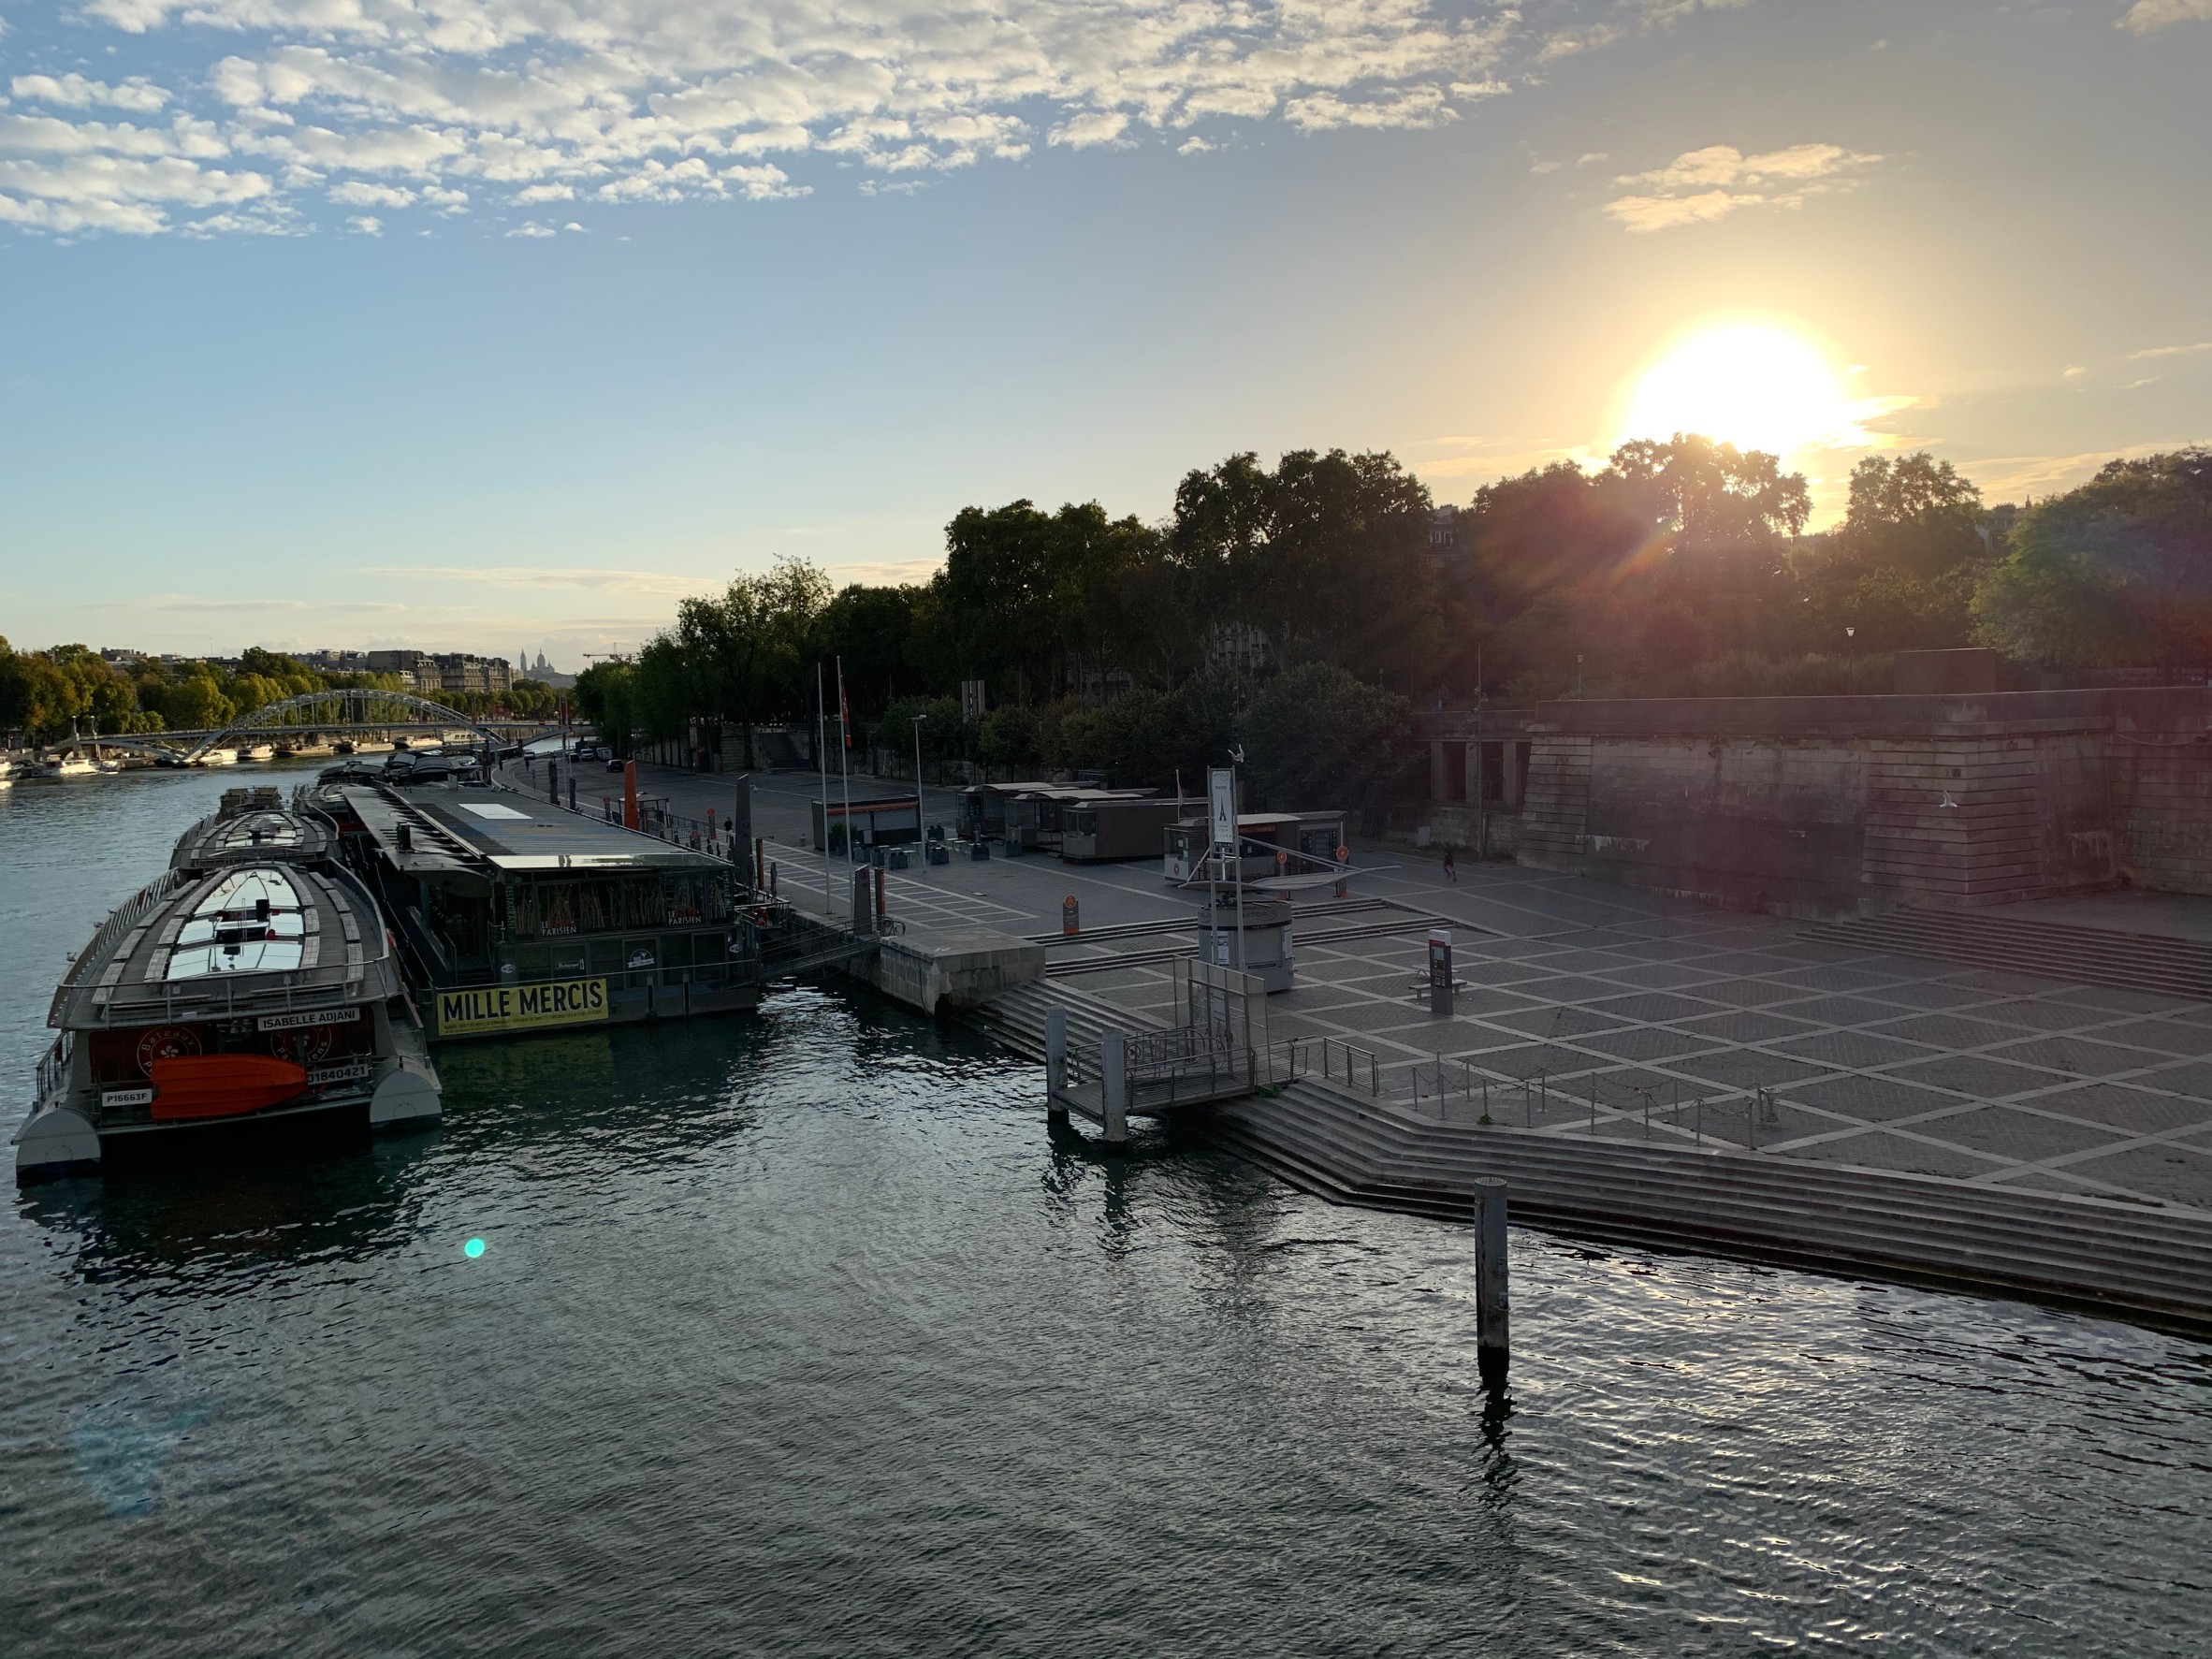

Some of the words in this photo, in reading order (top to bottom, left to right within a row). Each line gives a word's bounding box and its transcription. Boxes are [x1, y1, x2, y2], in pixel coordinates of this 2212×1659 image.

[505, 885, 516, 929] RESTAURANT
[541, 921, 550, 929] LE
[668, 916, 702, 925] PARISIEN
[542, 926, 576, 937] PARISIEN
[444, 991, 511, 1022] MILLE
[519, 982, 603, 1015] MERCIS
[264, 1014, 316, 1028] ISABELLE
[319, 1011, 355, 1023] ADJANI
[140, 1029, 195, 1051] Bateaux
